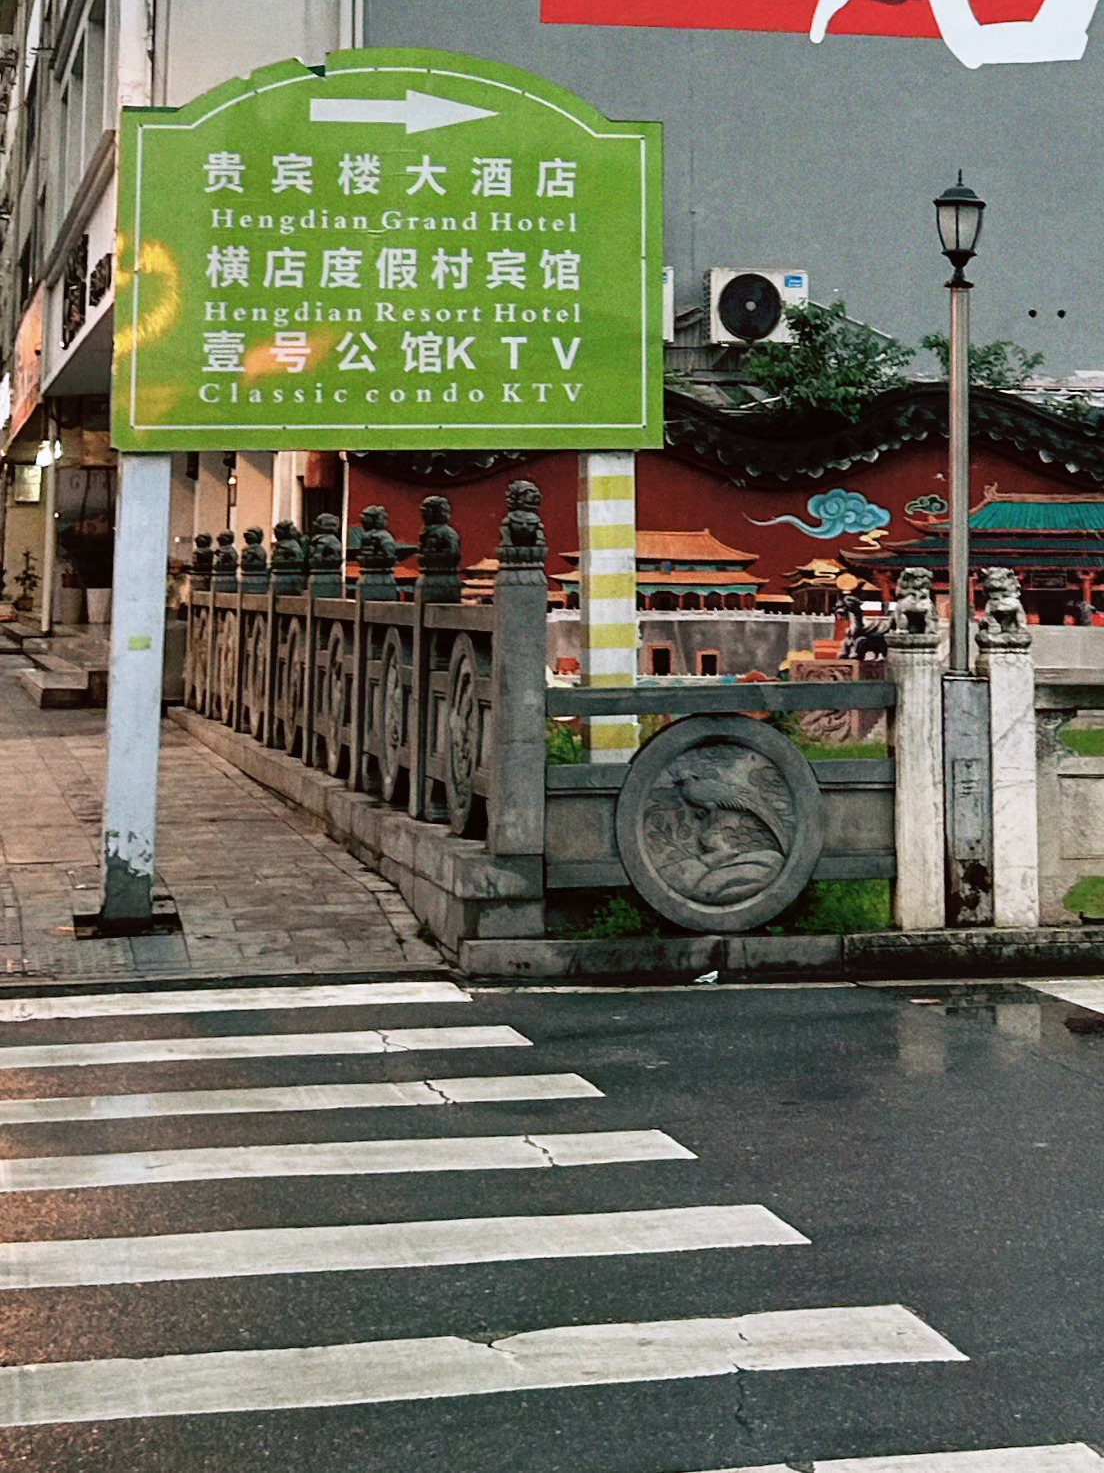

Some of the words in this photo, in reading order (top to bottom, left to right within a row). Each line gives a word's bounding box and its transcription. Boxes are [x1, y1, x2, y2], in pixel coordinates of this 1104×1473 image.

[203, 151, 577, 198] 贵宾楼大酒店
[211, 208, 369, 236] Hengdian
[381, 210, 479, 232] Grand
[490, 212, 578, 233] Hotel
[204, 245, 582, 291] 横店度假村宾馆
[204, 301, 363, 327] Hengdian
[376, 301, 482, 323] Resort
[494, 303, 582, 324] Hotel
[199, 382, 349, 404] Classic
[365, 382, 485, 404] condo
